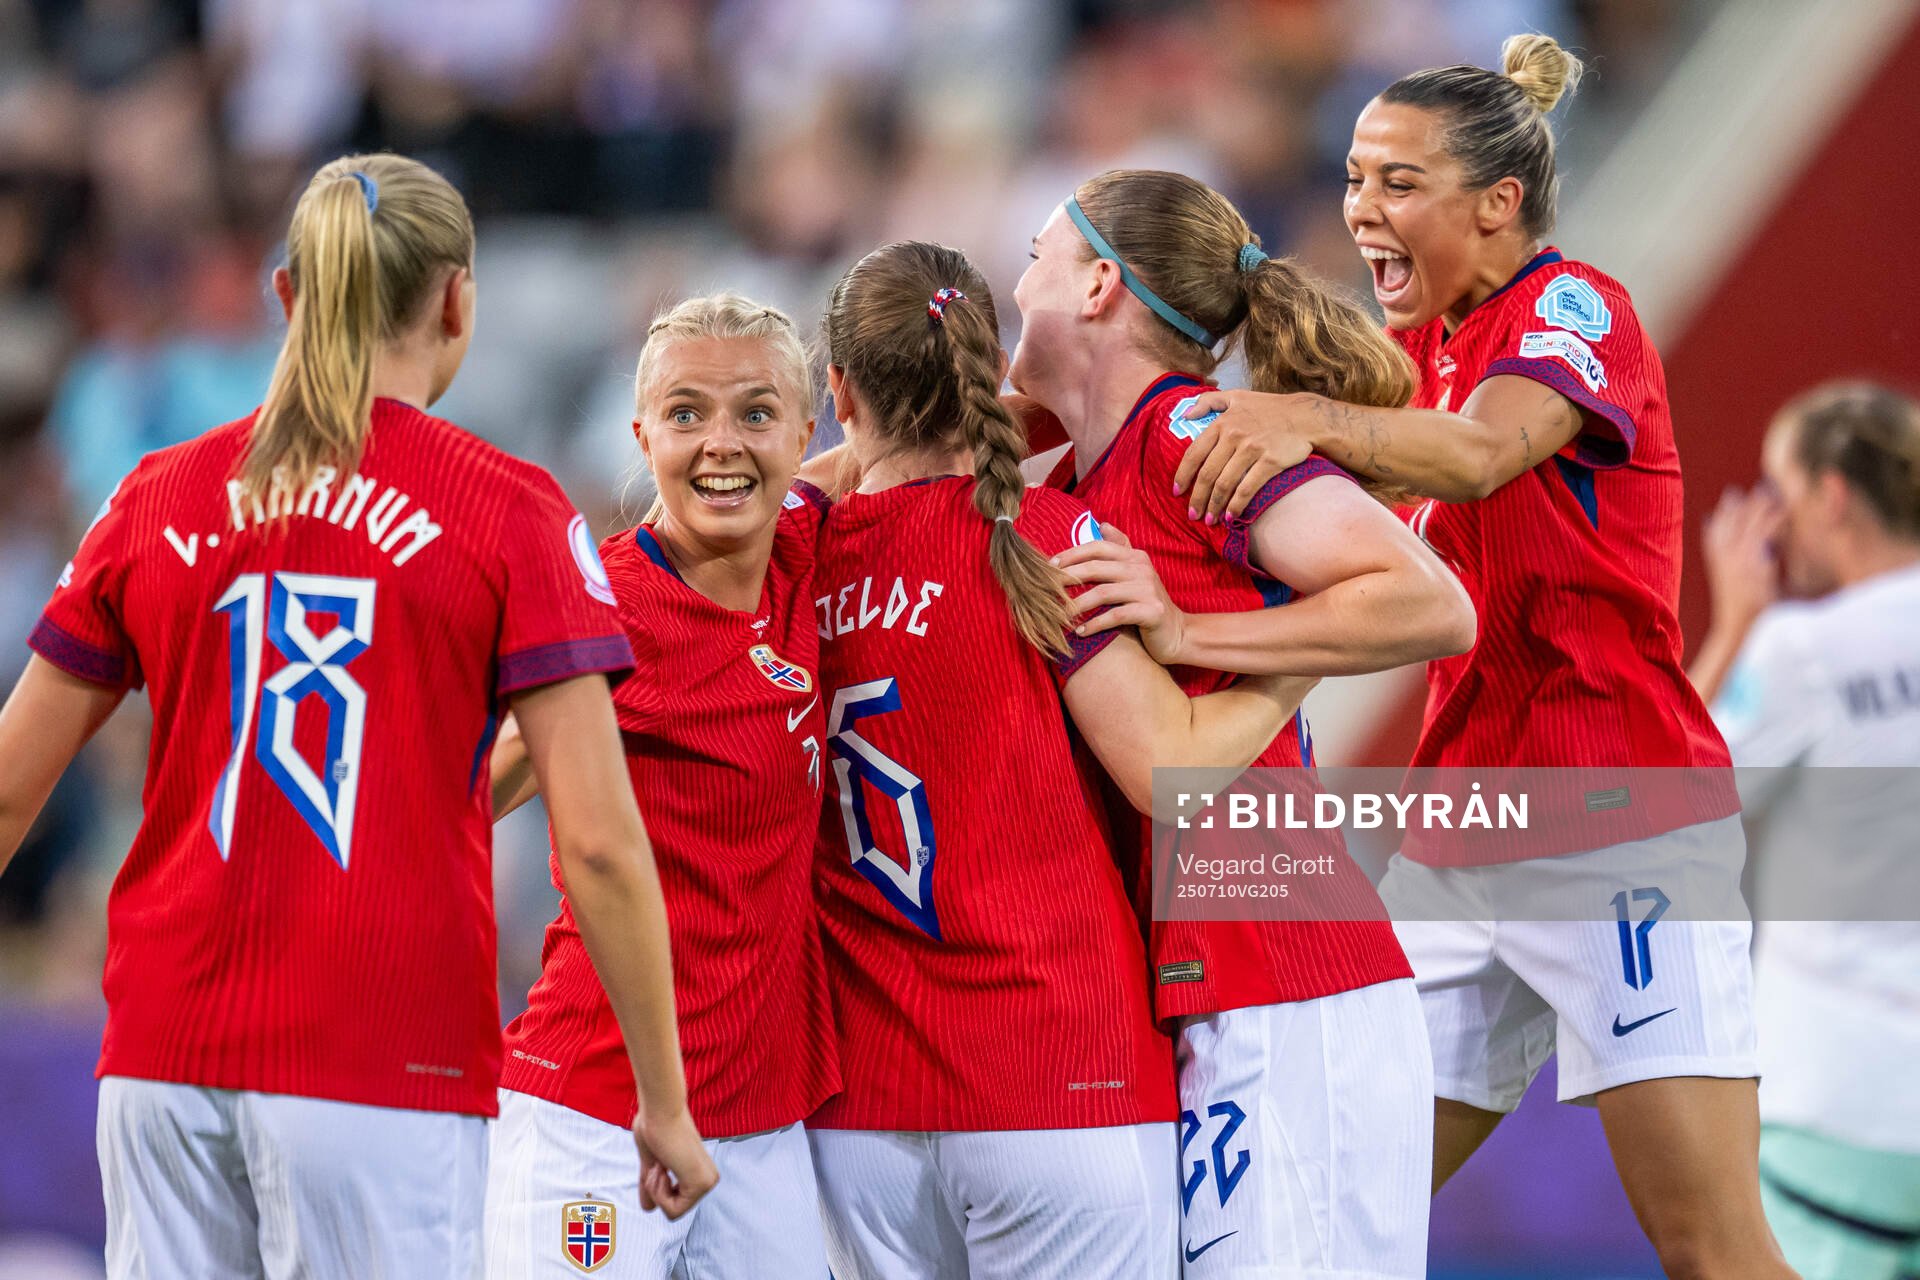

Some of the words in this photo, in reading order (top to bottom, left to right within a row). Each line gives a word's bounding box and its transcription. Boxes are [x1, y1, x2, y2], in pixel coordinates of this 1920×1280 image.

[208, 570, 377, 872] 18
[825, 675, 943, 942] 6
[1609, 886, 1672, 992] 17
[1181, 1100, 1251, 1218] 22
